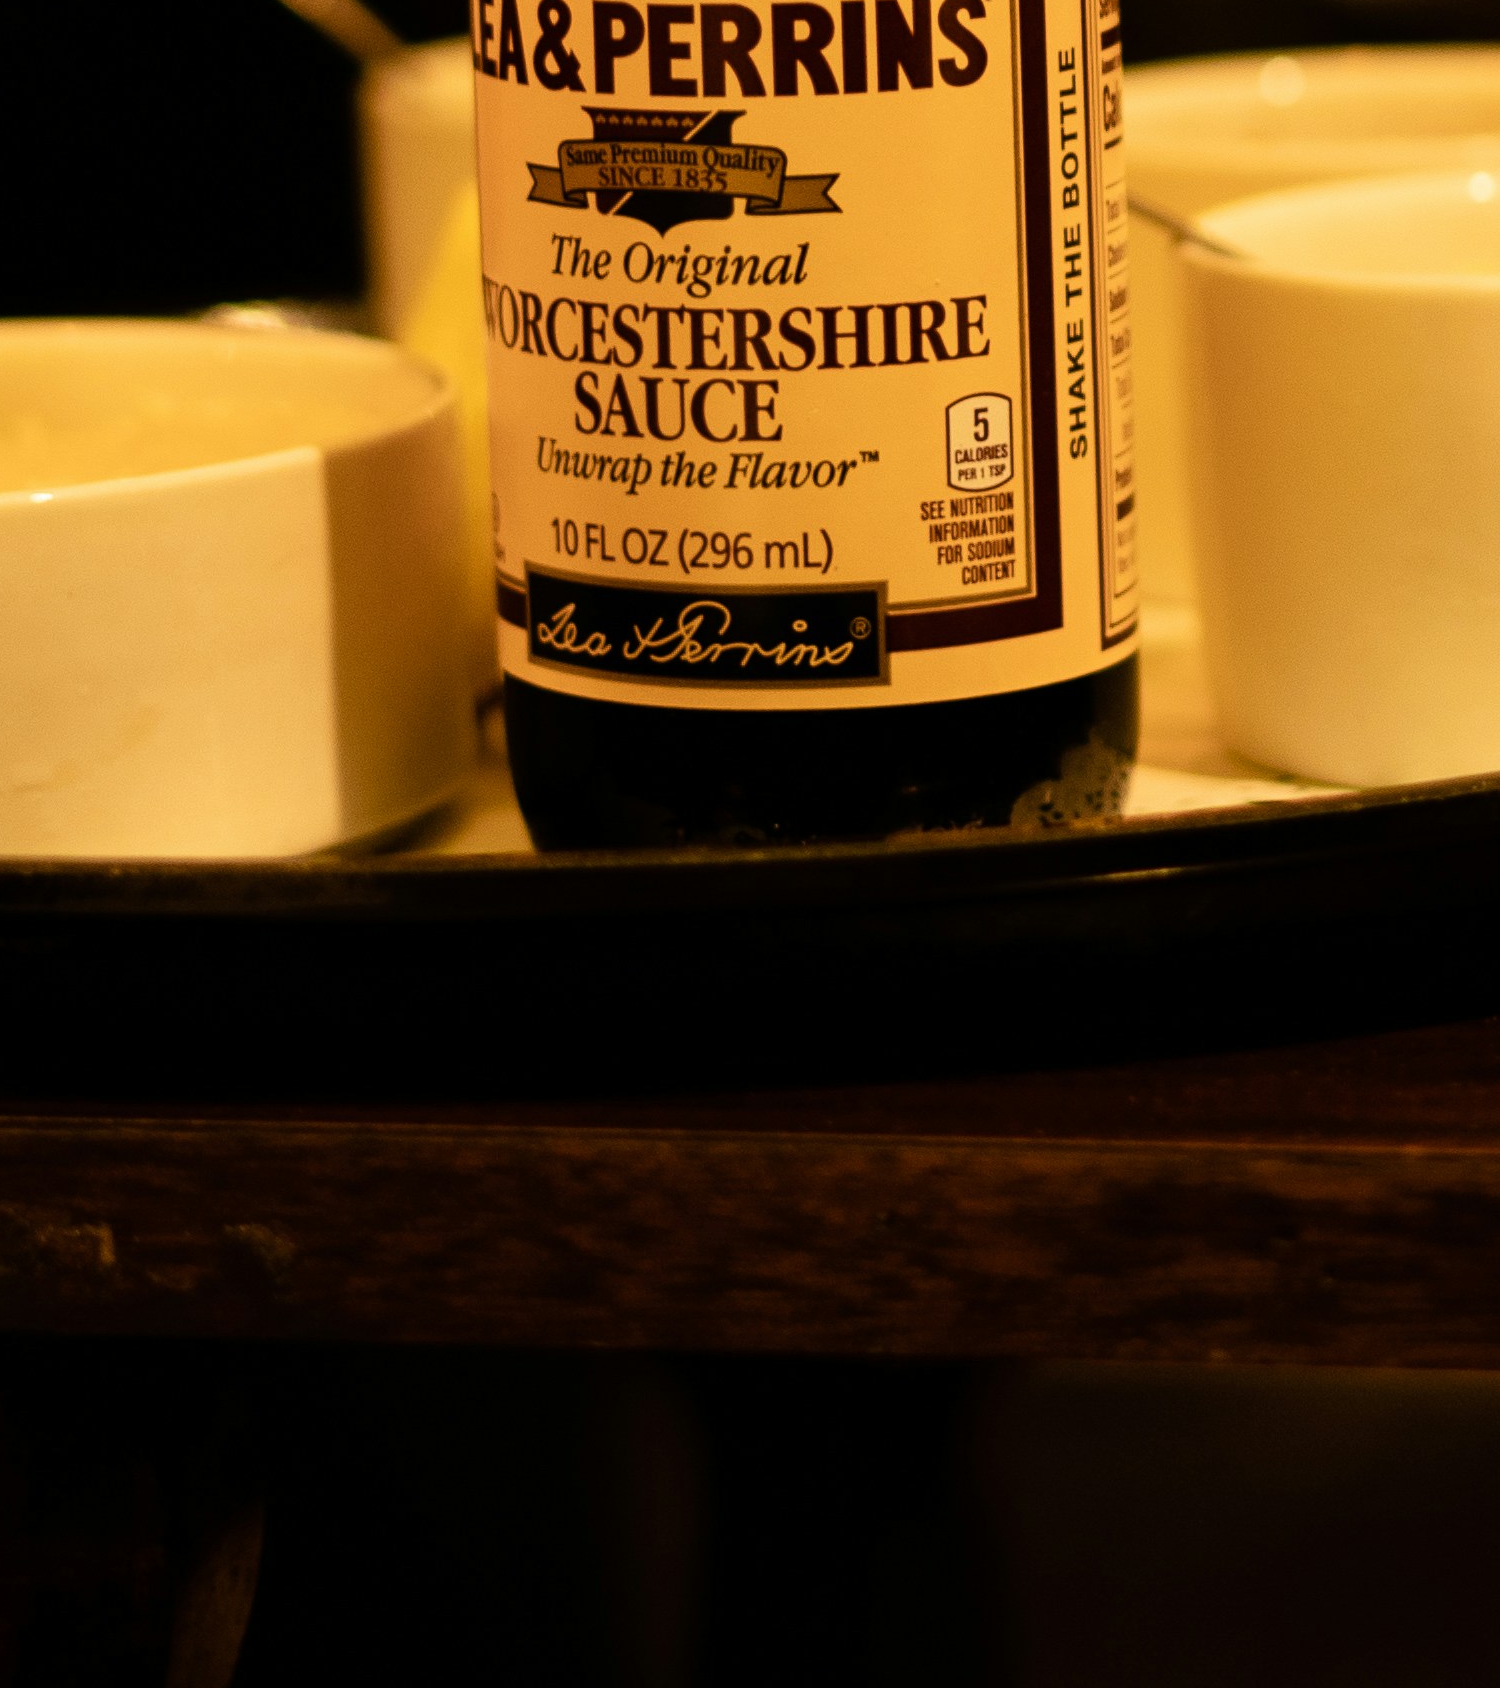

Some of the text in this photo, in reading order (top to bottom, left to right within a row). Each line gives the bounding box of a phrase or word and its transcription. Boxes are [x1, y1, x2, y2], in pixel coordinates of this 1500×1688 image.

[566, 142, 782, 178] Same Premium Quality
[599, 166, 728, 192] SINCE 1835
[551, 233, 810, 298] The Original
[1058, 46, 1088, 460] SHAKE THE BOTTLE
[574, 370, 783, 443] SAUCE
[973, 407, 989, 442] 5
[536, 436, 652, 496] Unwrap
[660, 450, 717, 489] the
[955, 443, 1008, 464] CALORIES
[958, 470, 978, 482] PER
[988, 464, 1005, 478] TSP
[920, 490, 1015, 521] SEE NUTRITION
[551, 517, 579, 557] 10
[584, 523, 616, 562] FL
[622, 526, 670, 566] OZ
[677, 528, 754, 574] (296
[764, 528, 834, 574] mL)
[929, 514, 1015, 544] INFORMATION
[937, 536, 1015, 565] FOR SODIUM
[961, 559, 1016, 586] CONTENT
[537, 602, 612, 656] Lea
